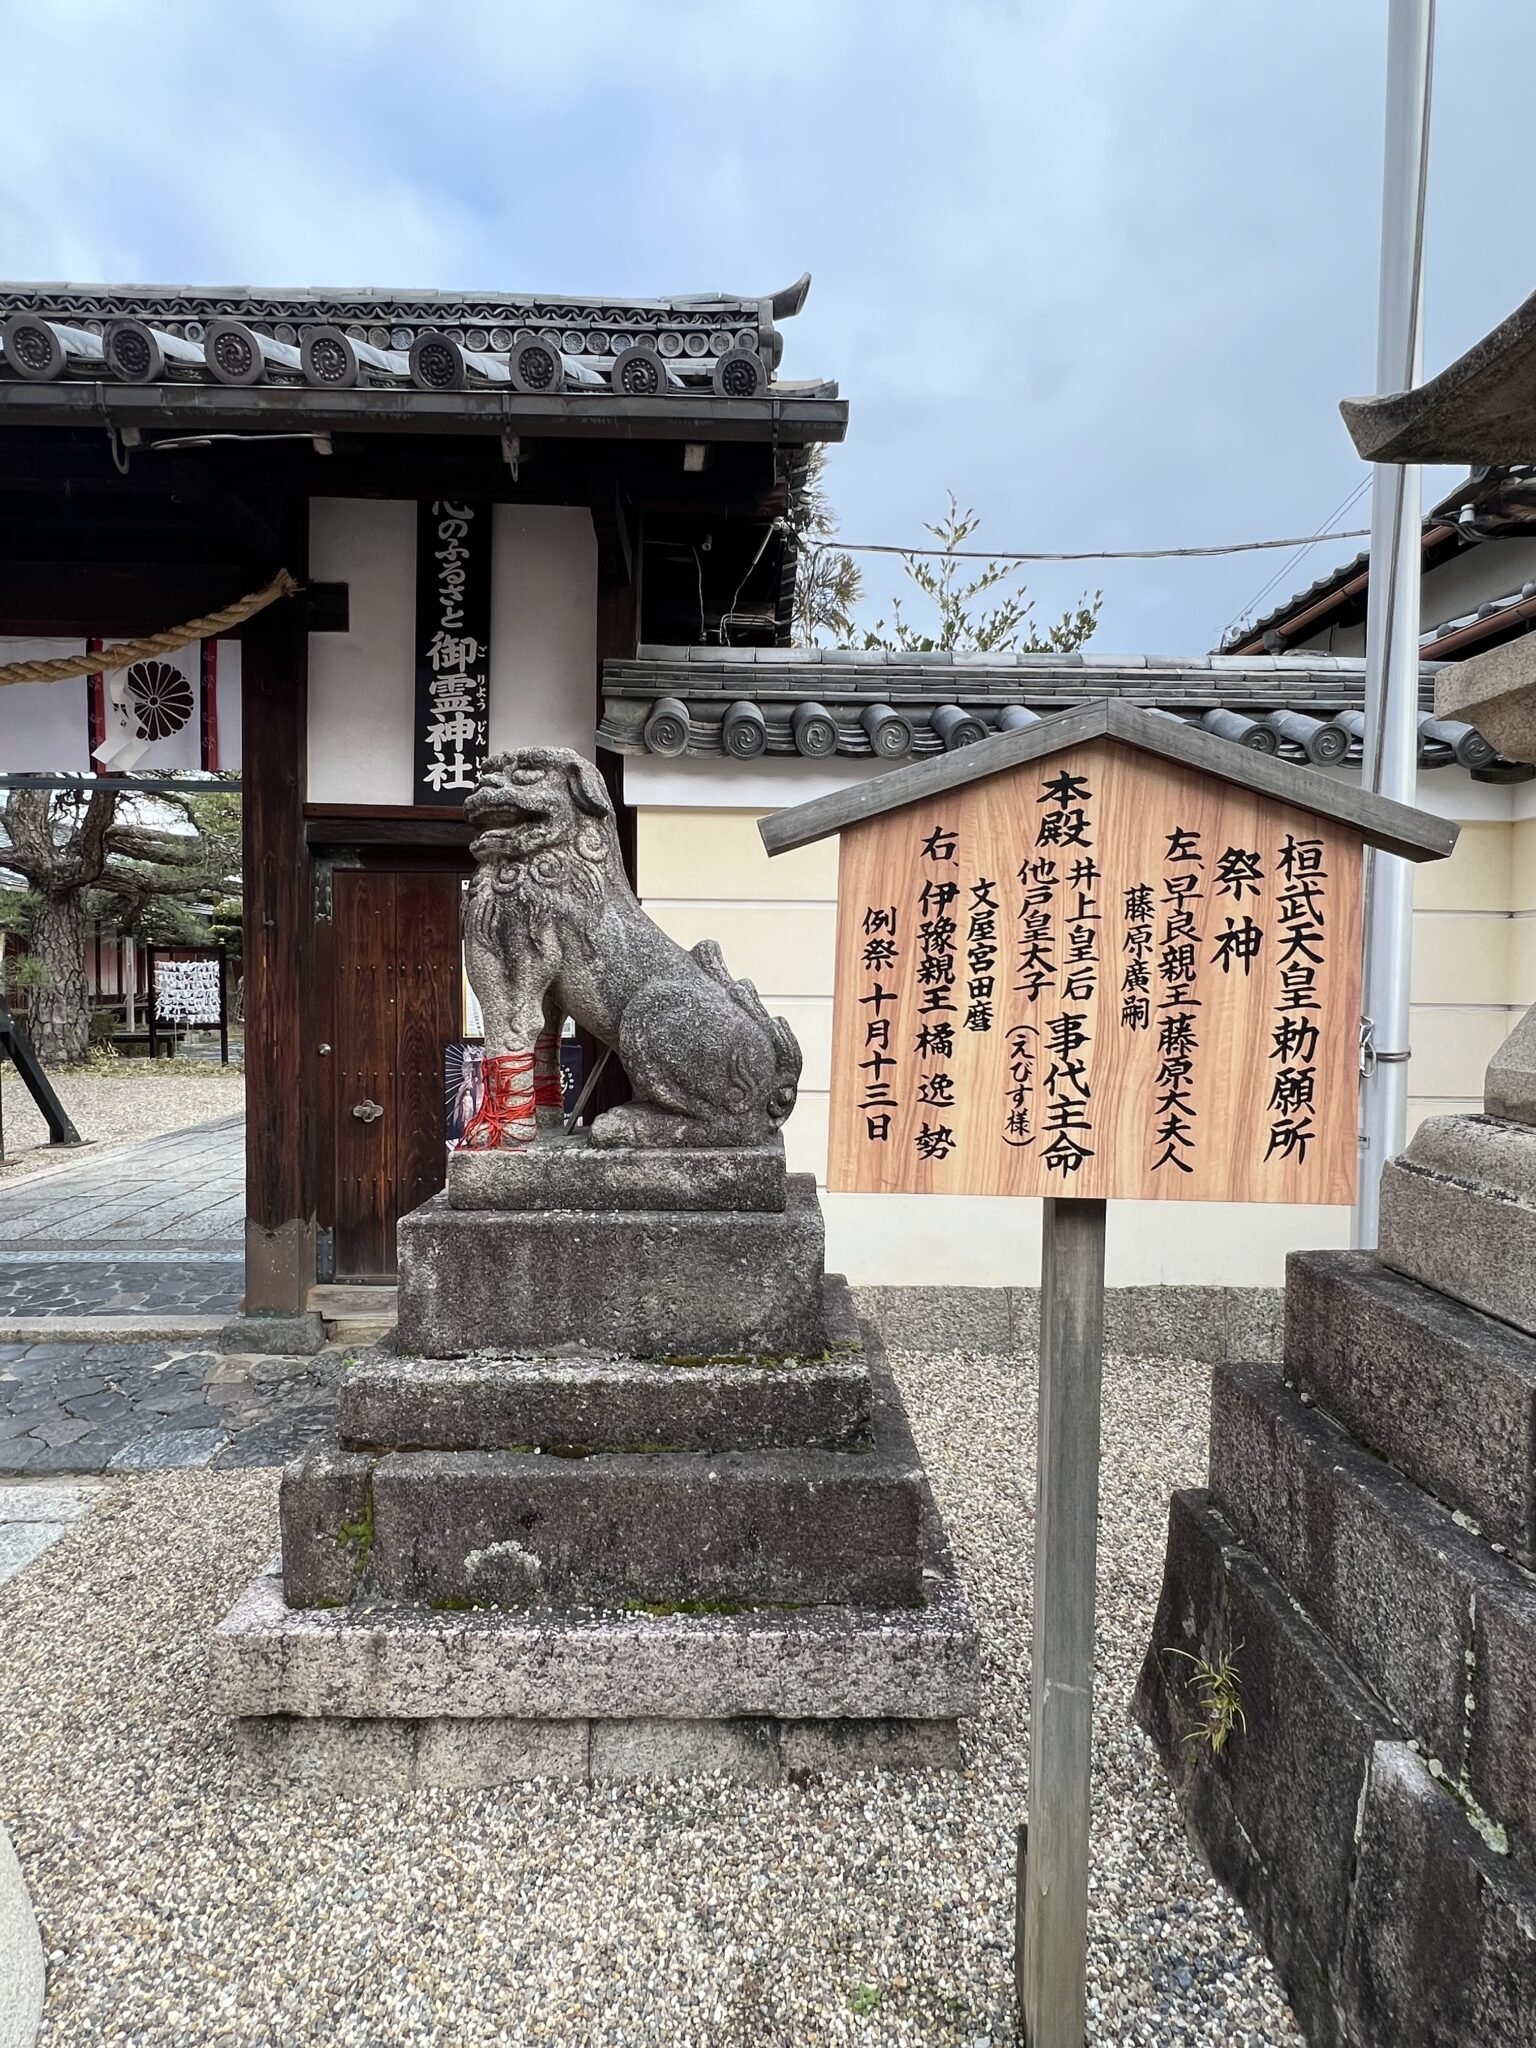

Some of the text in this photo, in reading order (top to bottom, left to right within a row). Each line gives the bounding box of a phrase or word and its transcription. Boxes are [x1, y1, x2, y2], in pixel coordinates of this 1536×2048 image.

[1035, 769, 1093, 849] 本殿
[1013, 856, 1060, 1003] 他戸皇太子
[1061, 856, 1102, 1001] 井上皇后
[1120, 882, 1156, 1032] 藤原廣嗣
[1209, 846, 1265, 977] 祭神
[1262, 833, 1328, 1166] 桓武天皇勅願所
[1037, 1011, 1096, 1179] 事代主命
